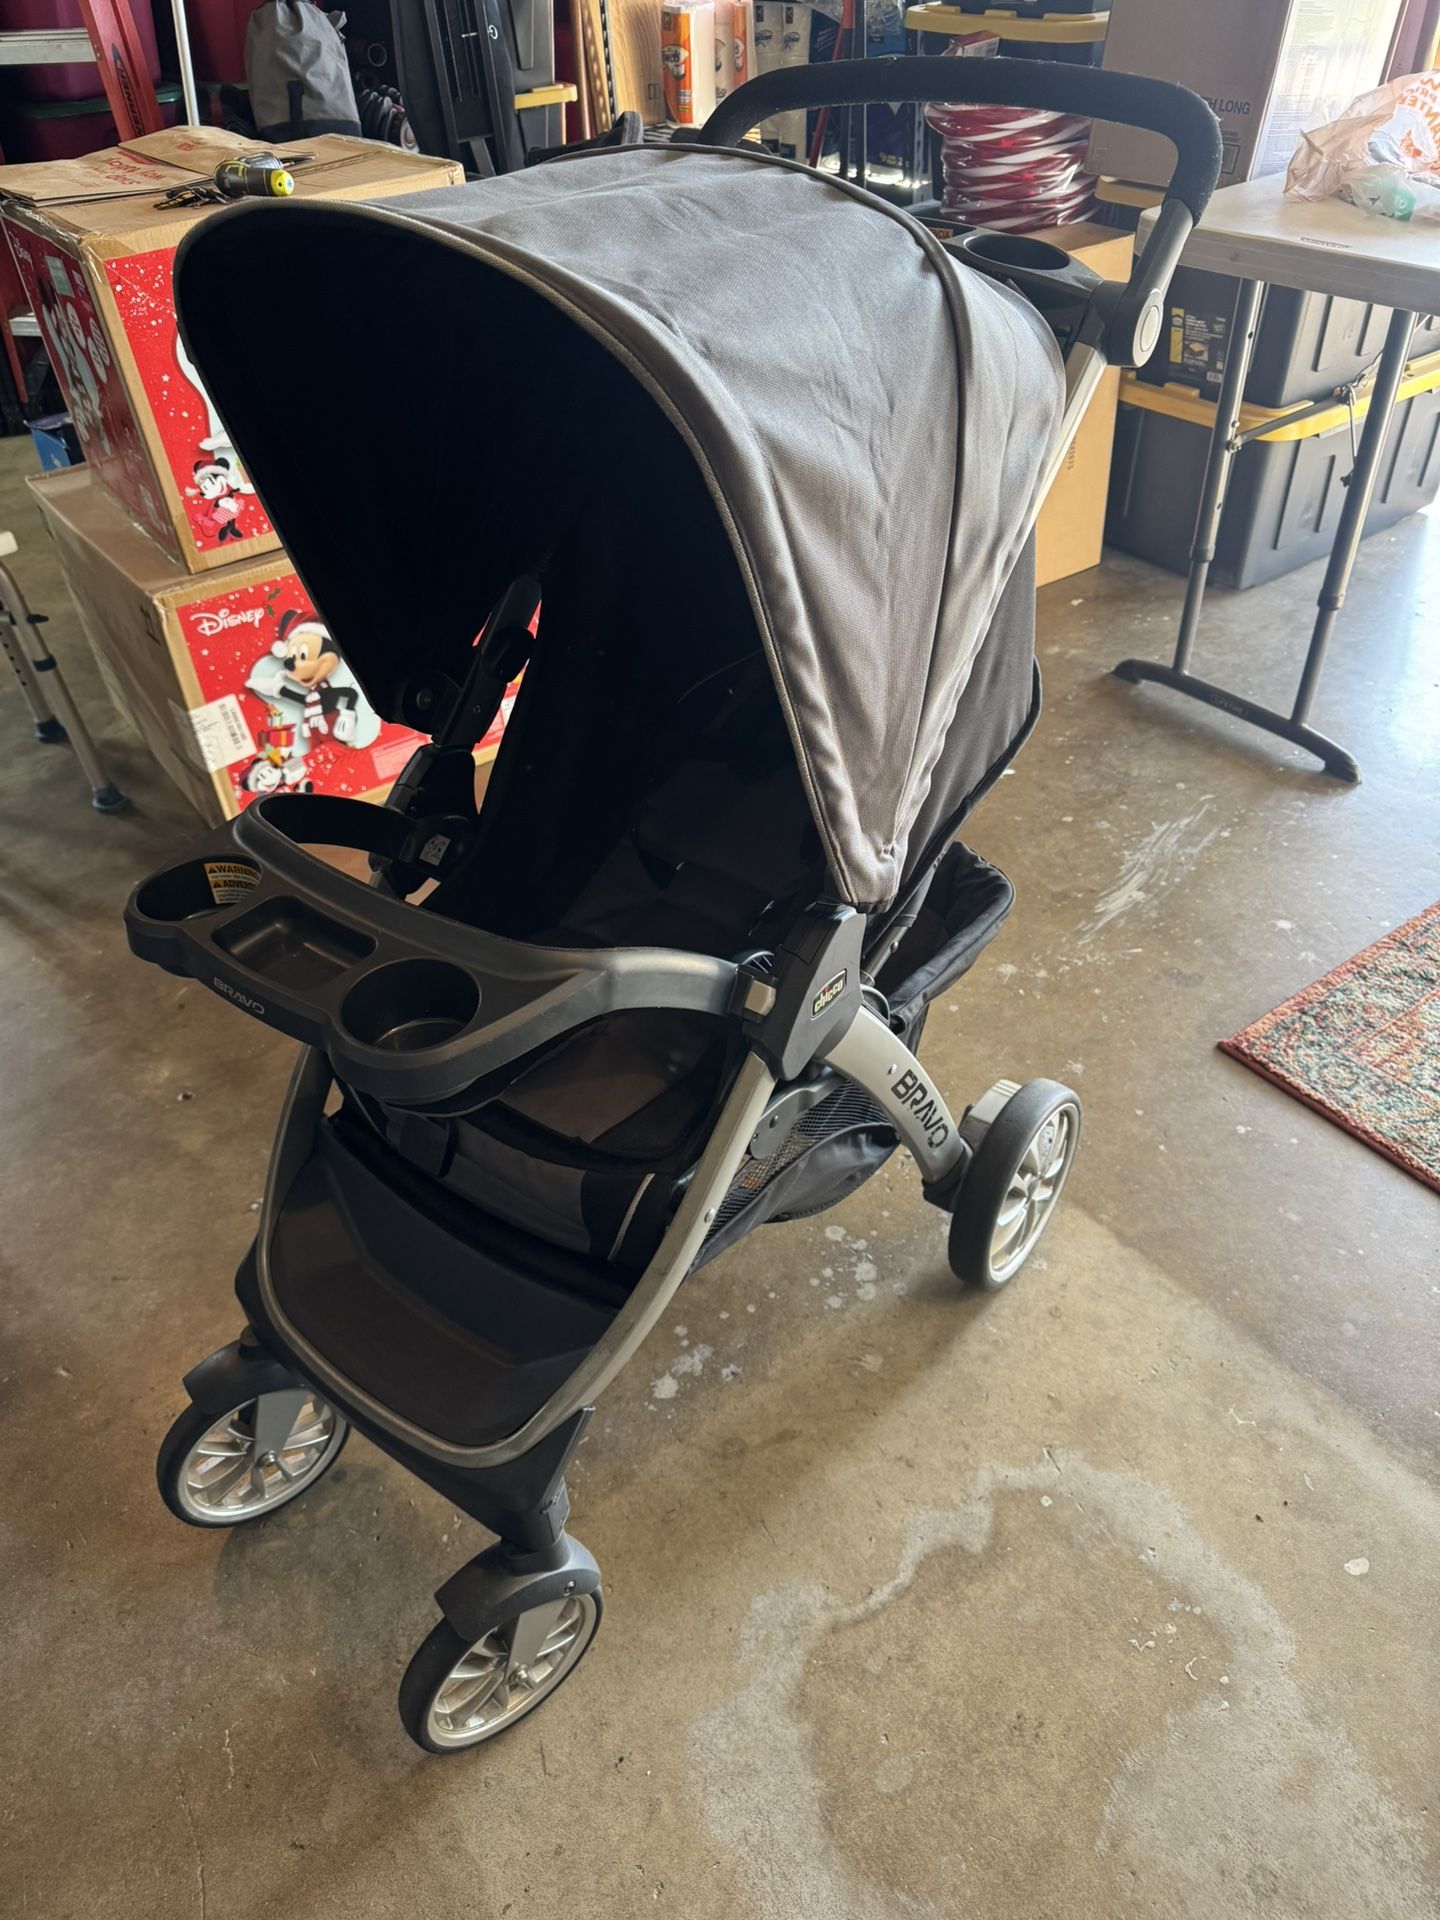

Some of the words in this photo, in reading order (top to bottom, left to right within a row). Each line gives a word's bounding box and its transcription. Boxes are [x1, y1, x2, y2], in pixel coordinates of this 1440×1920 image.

[1219, 100, 1251, 115] LONG
[213, 976, 265, 1015] BRAVO
[814, 978, 844, 1013] chicco
[890, 1068, 949, 1149] BRAVO
